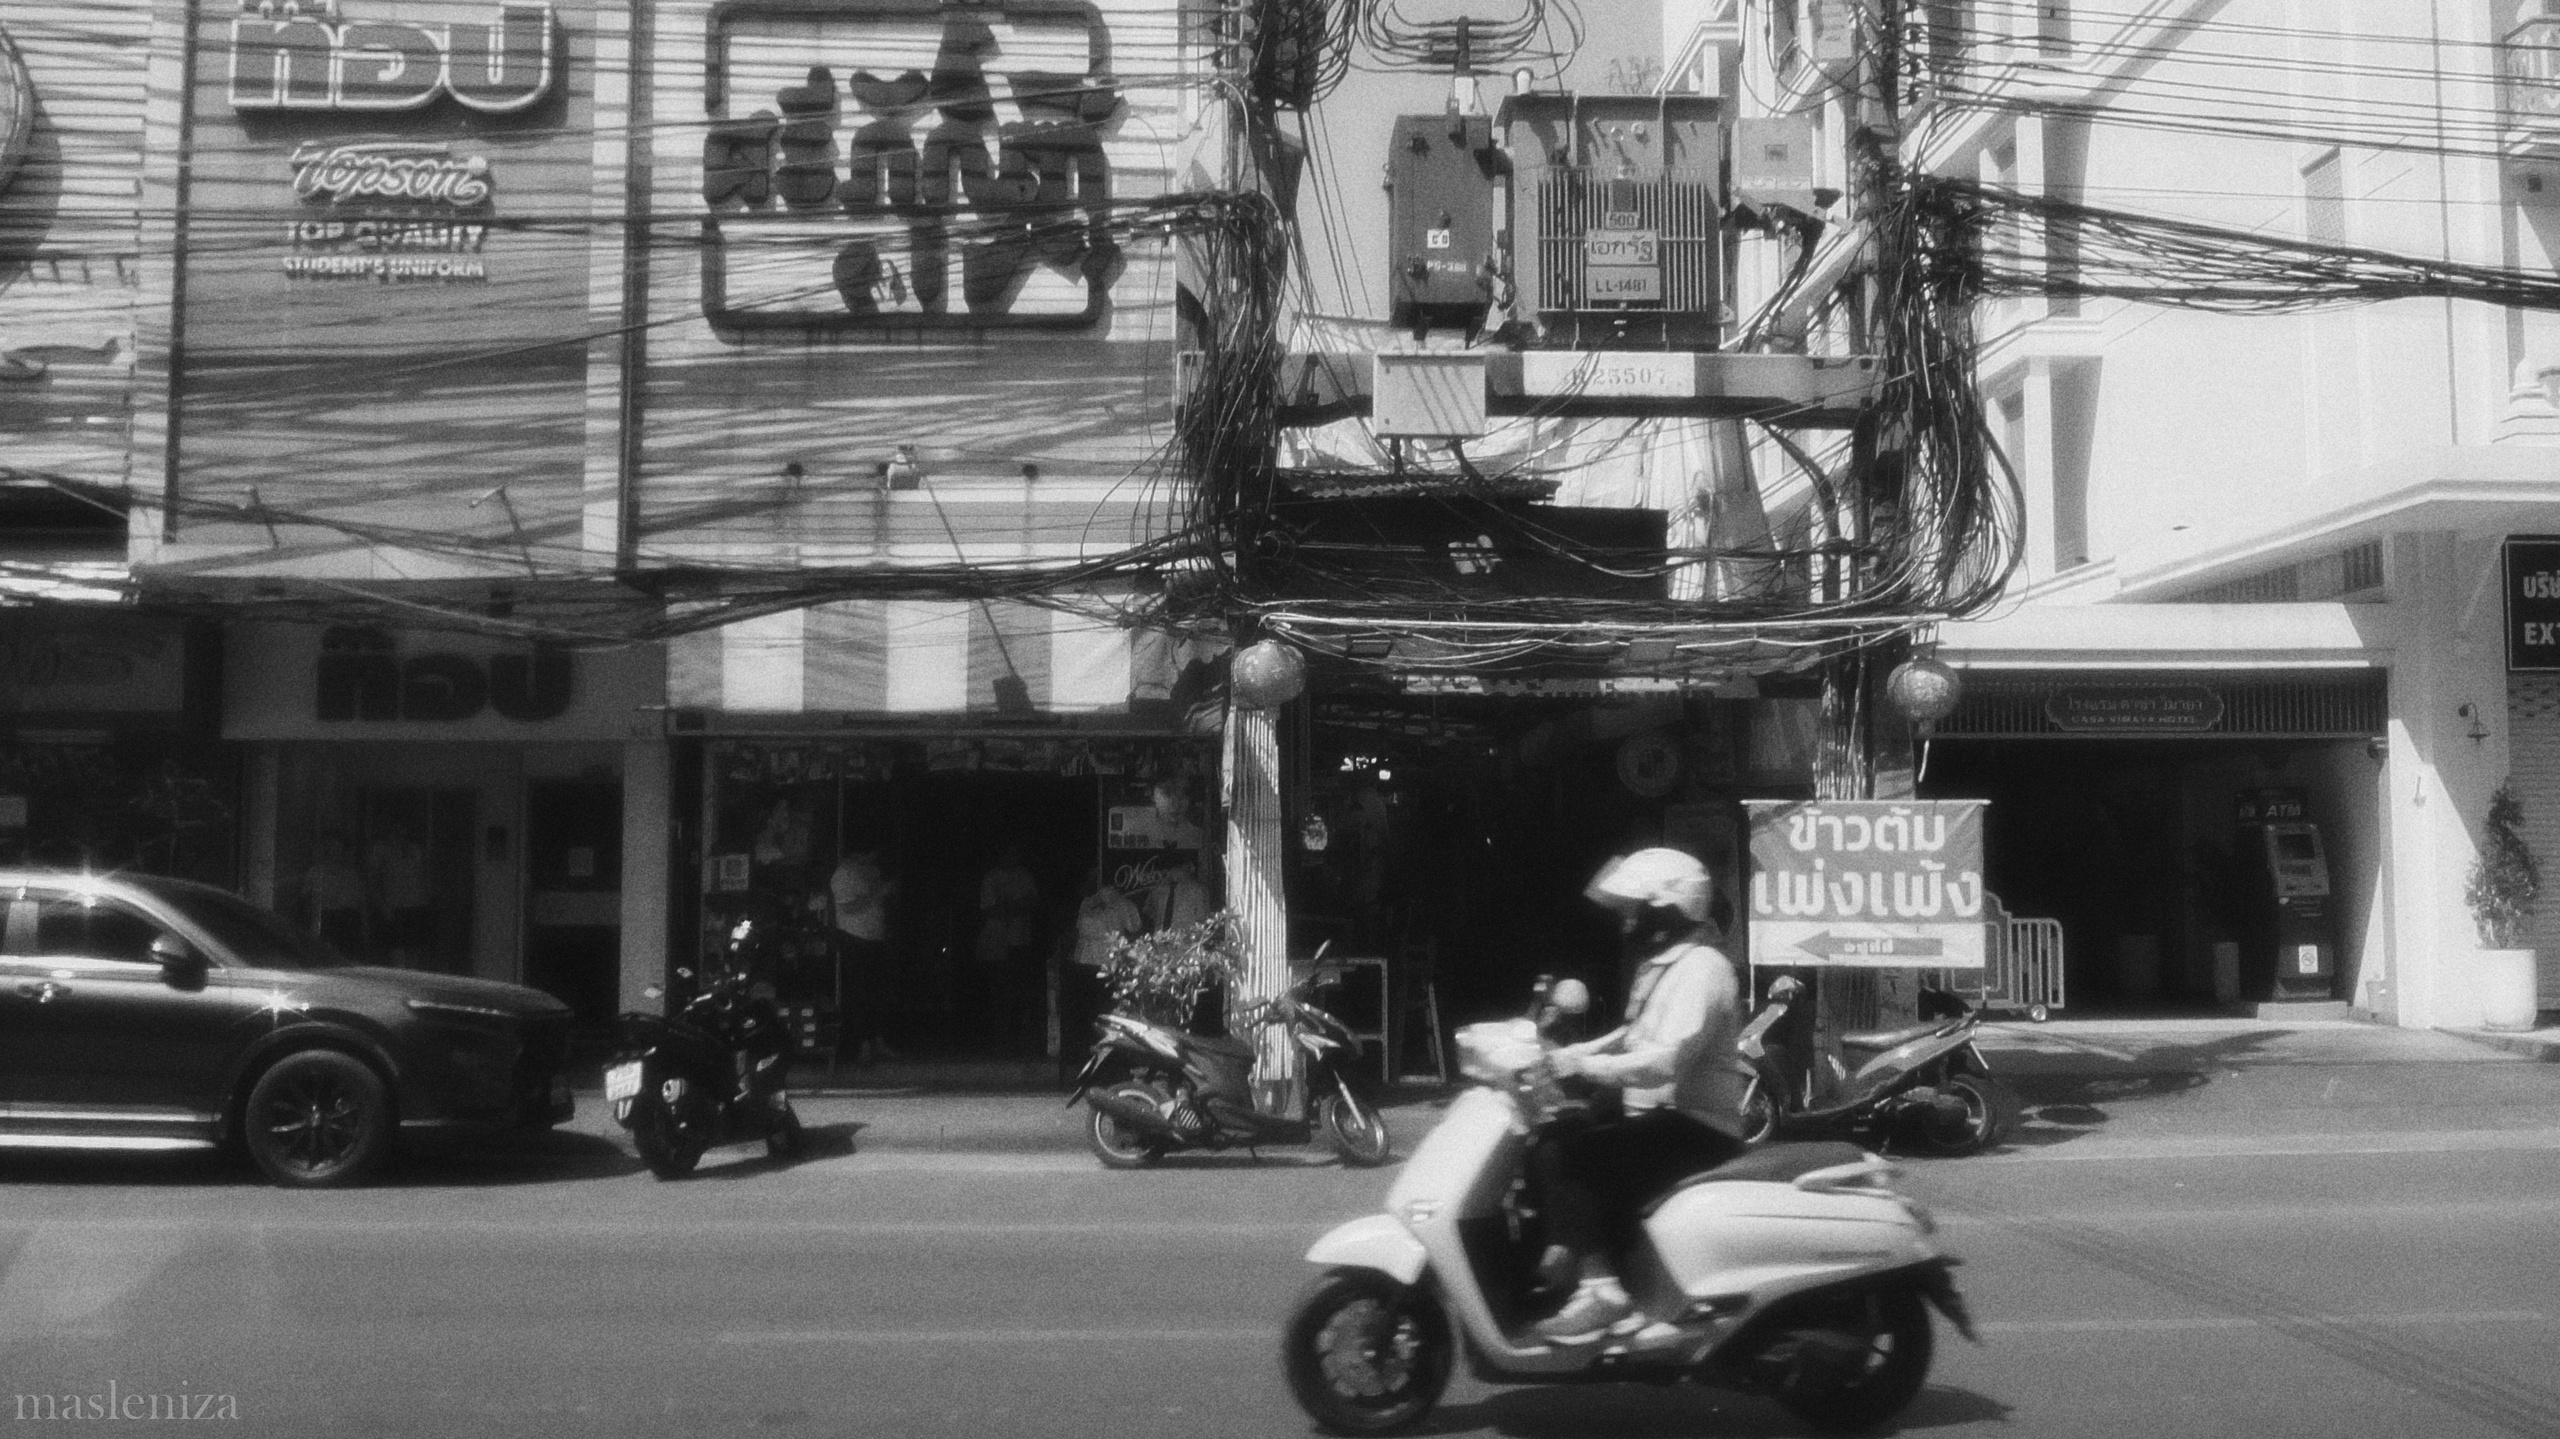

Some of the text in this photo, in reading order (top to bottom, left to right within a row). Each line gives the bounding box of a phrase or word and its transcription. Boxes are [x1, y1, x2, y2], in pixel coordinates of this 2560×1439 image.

[287, 220, 484, 247] TOP QUALITY
[283, 256, 485, 277] STUDENT'S UNIFORM
[2524, 622, 2560, 646] EX
[2265, 803, 2302, 818] ATM
[1788, 806, 1946, 852] ข้าวต้ม
[1754, 858, 1982, 917] เพ่งเพ้ง
